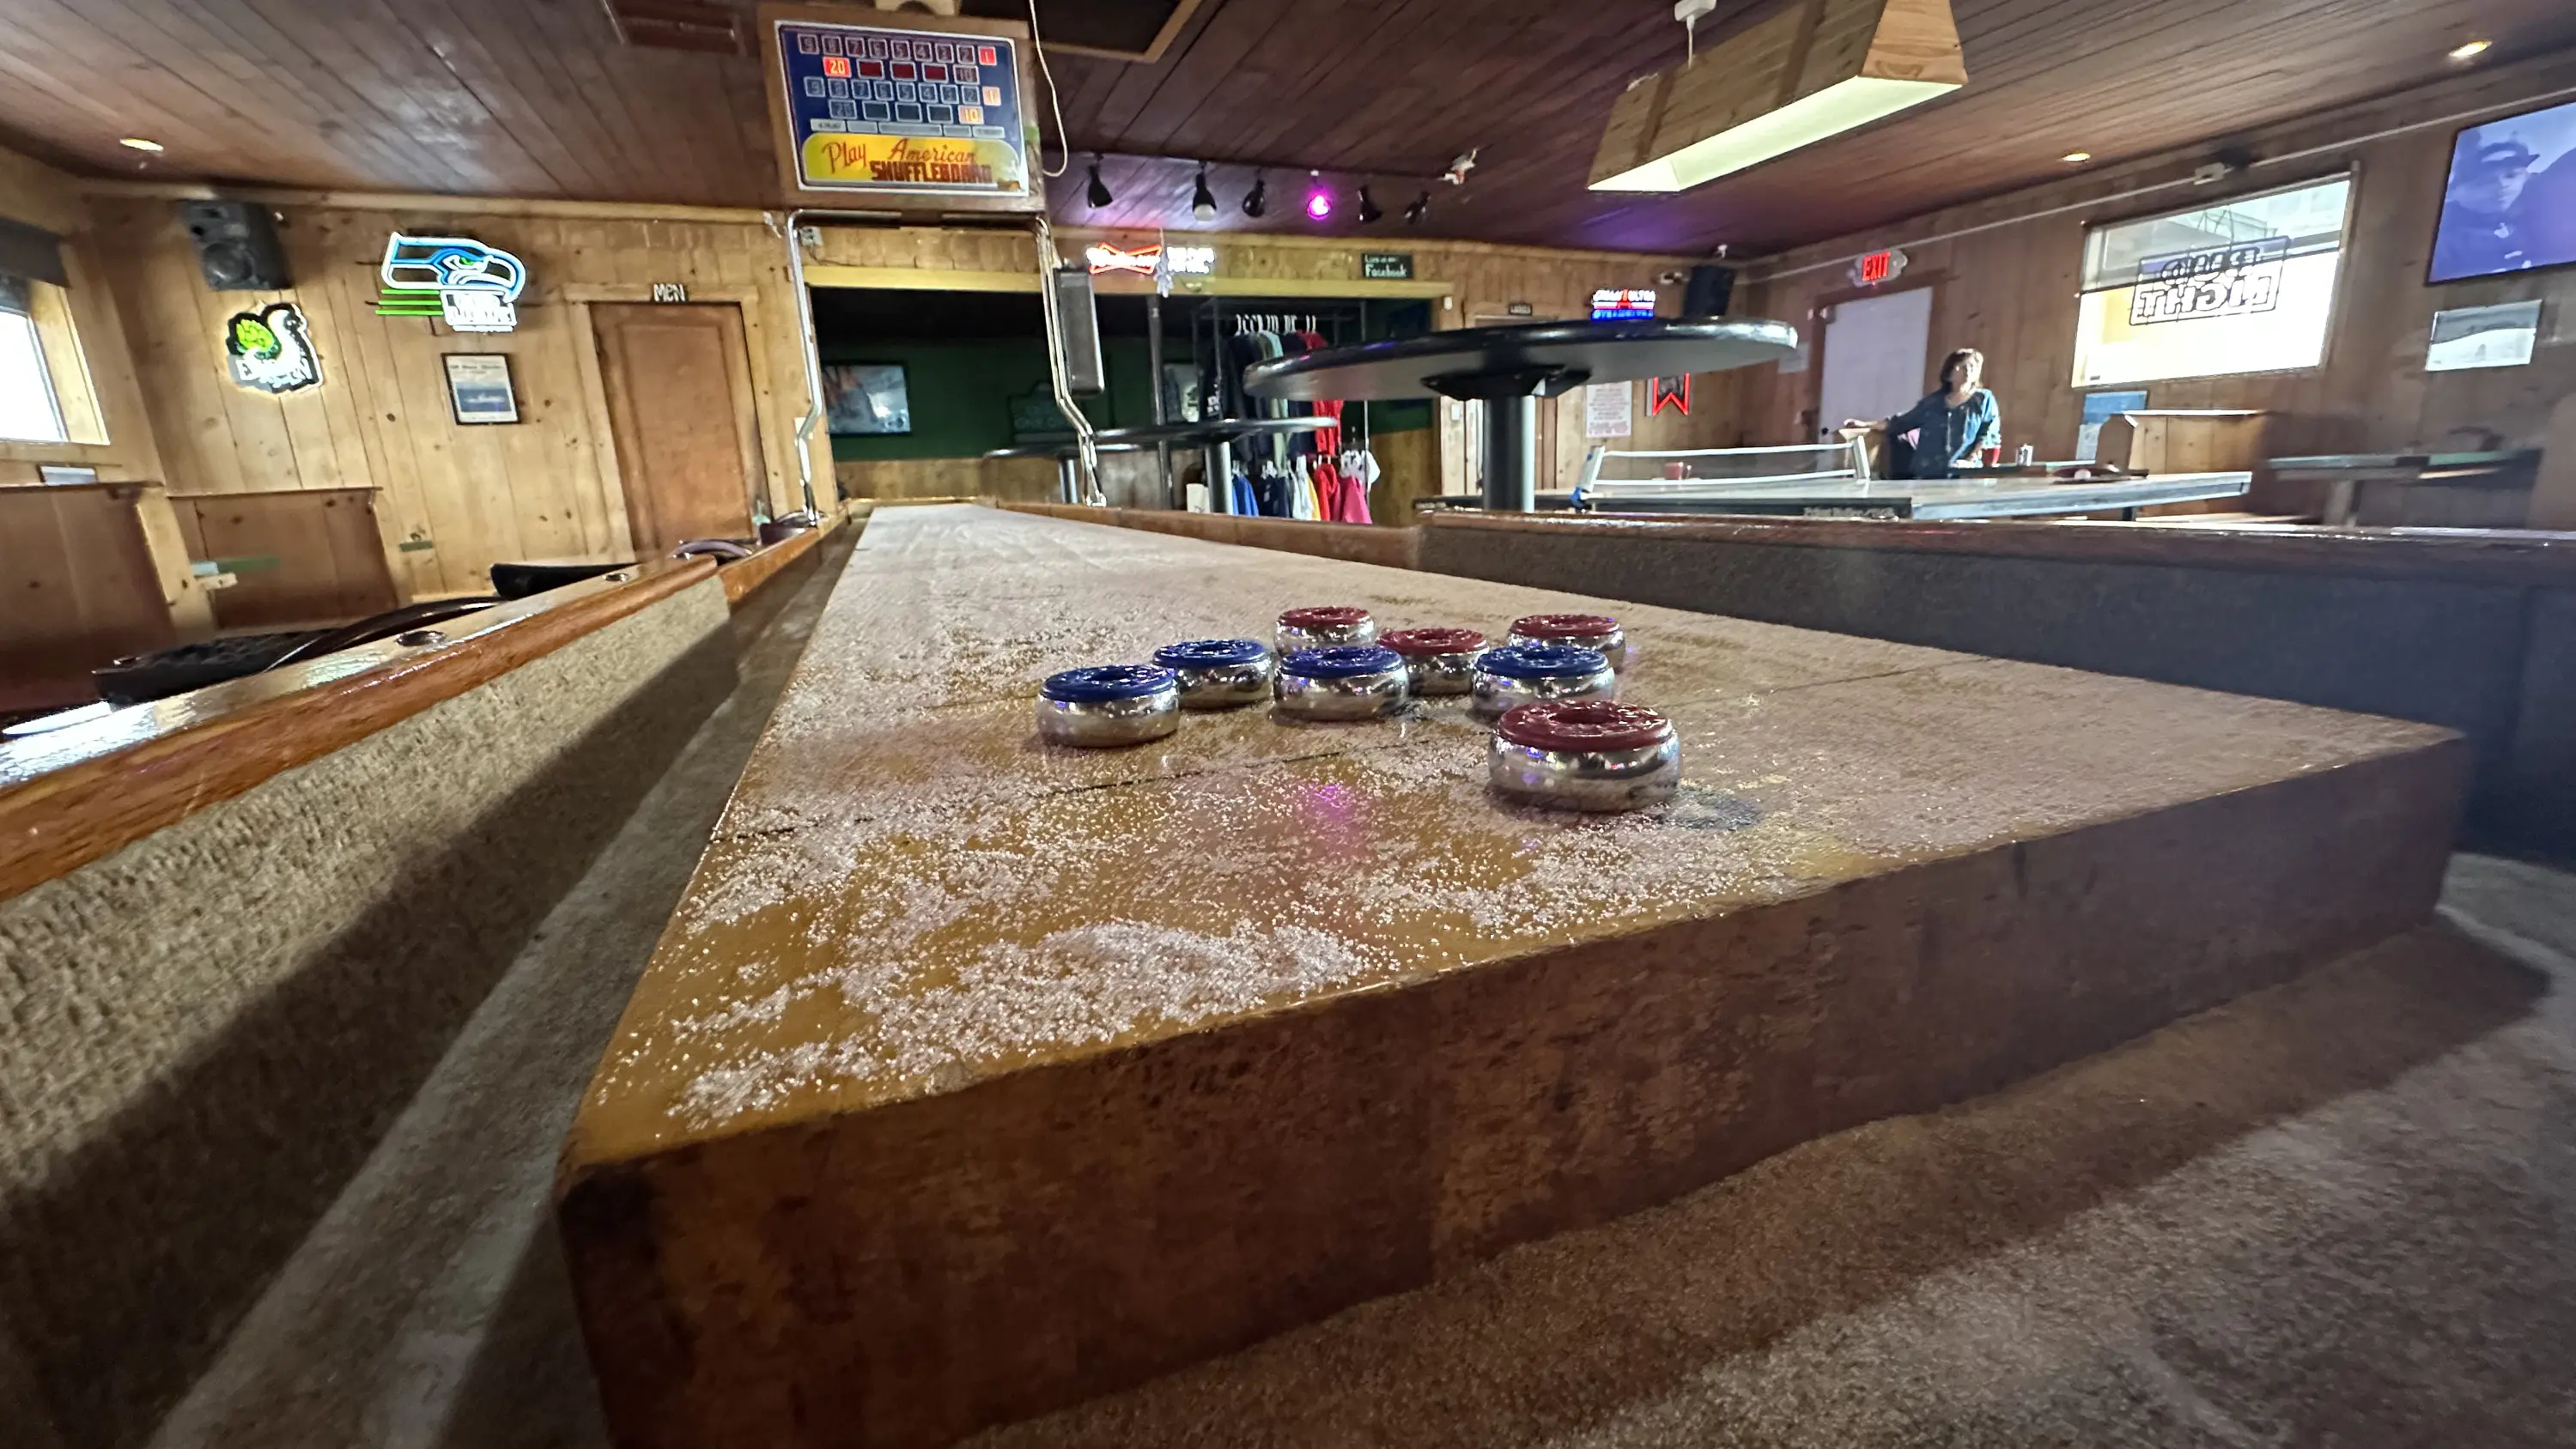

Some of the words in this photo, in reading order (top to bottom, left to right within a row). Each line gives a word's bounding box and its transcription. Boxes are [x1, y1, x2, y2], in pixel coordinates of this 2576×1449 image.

[829, 59, 846, 74] 20
[964, 108, 979, 122] 10
[822, 141, 867, 173] Play
[888, 138, 976, 163] American
[870, 161, 992, 184] SHUFFLEBOARD
[1862, 250, 1891, 282] EXIT
